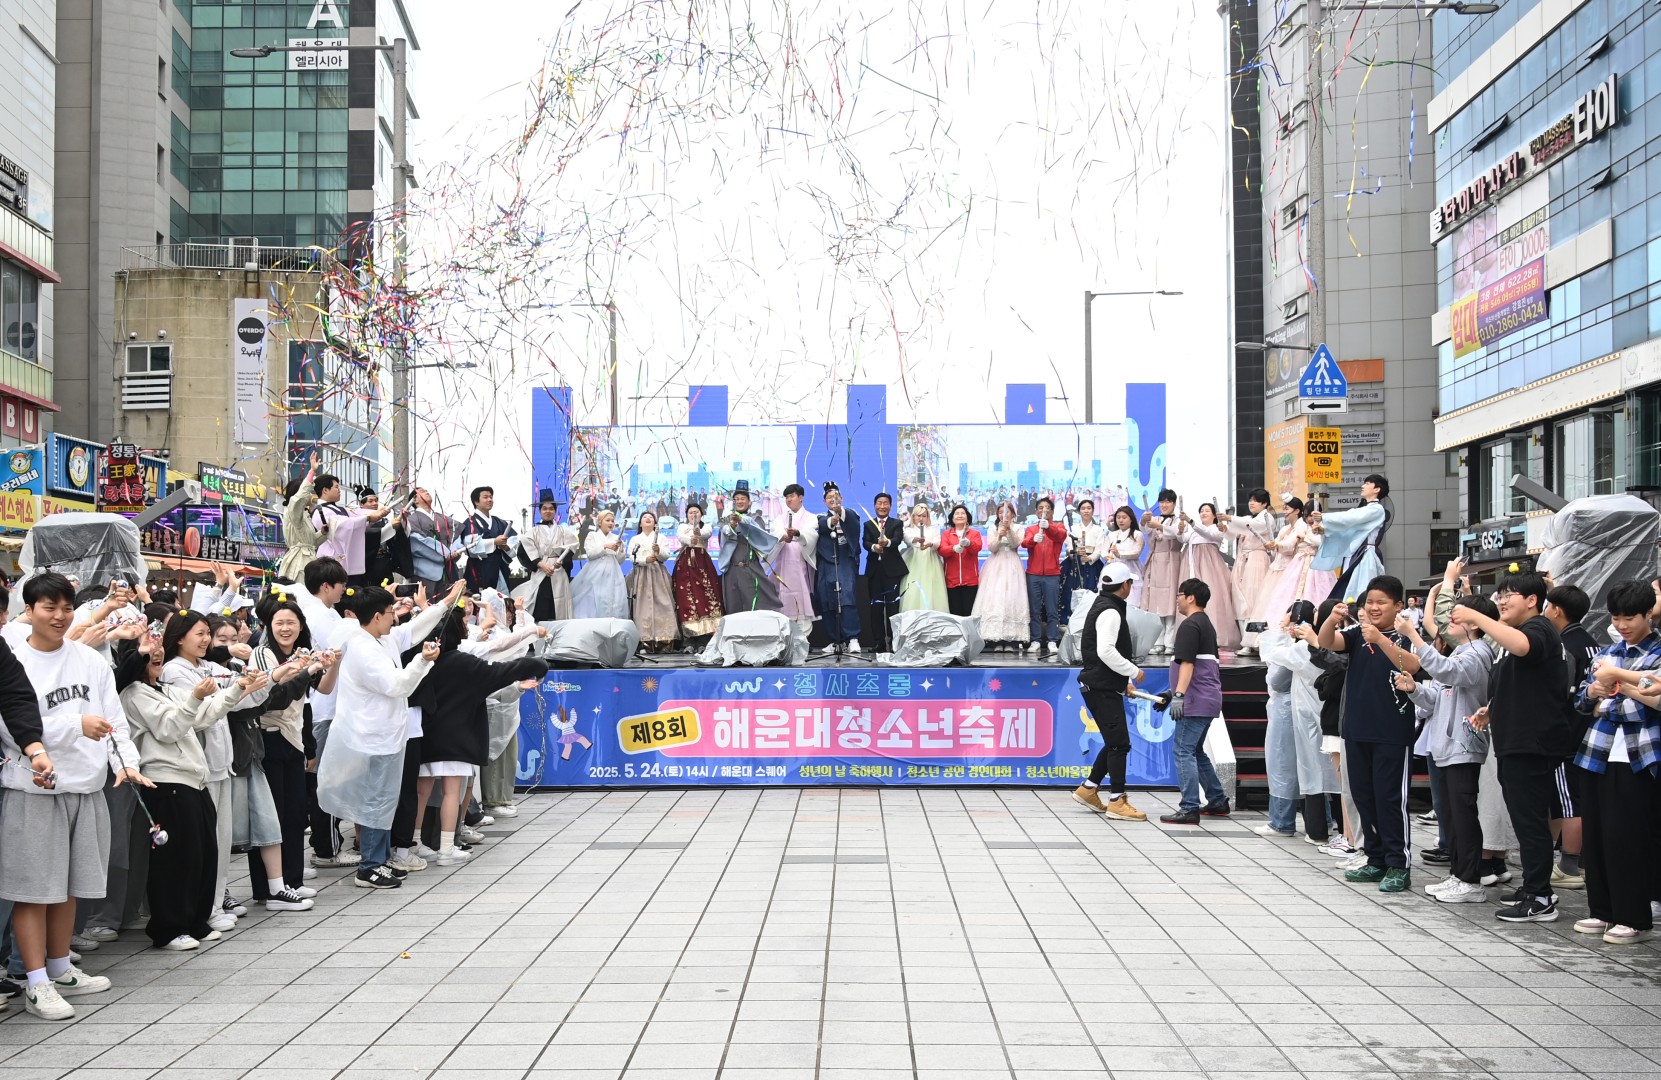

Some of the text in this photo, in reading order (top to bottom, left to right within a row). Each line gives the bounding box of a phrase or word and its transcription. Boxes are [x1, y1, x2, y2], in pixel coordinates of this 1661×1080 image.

[306, 0, 344, 29] A
[295, 55, 342, 67] 엘리시아
[1575, 73, 1616, 144] 타이
[1544, 114, 1573, 144] MASSAGE
[17, 195, 27, 208] 3F
[1453, 299, 1478, 351] 임대
[1479, 300, 1544, 341] 010-2860-0424
[1306, 387, 1340, 396] 횡단보도
[1286, 421, 1305, 436] TOUCH
[110, 445, 136, 458] 정통
[1309, 442, 1336, 453] CCTV
[109, 464, 137, 479] 王家
[104, 482, 145, 502] 탕후루
[1482, 529, 1504, 550] GS25
[793, 672, 911, 696] 청사초롱
[631, 716, 687, 744] 제8회
[713, 706, 1036, 749] 해운대청소년축제
[589, 766, 622, 778] 2025.
[685, 765, 709, 778] 14시
[720, 765, 753, 778] 해운대
[755, 765, 787, 778] 스퀘어
[799, 764, 894, 778] 성년의 날 축하행사
[906, 765, 1013, 778] 청소년 공연 경연대회
